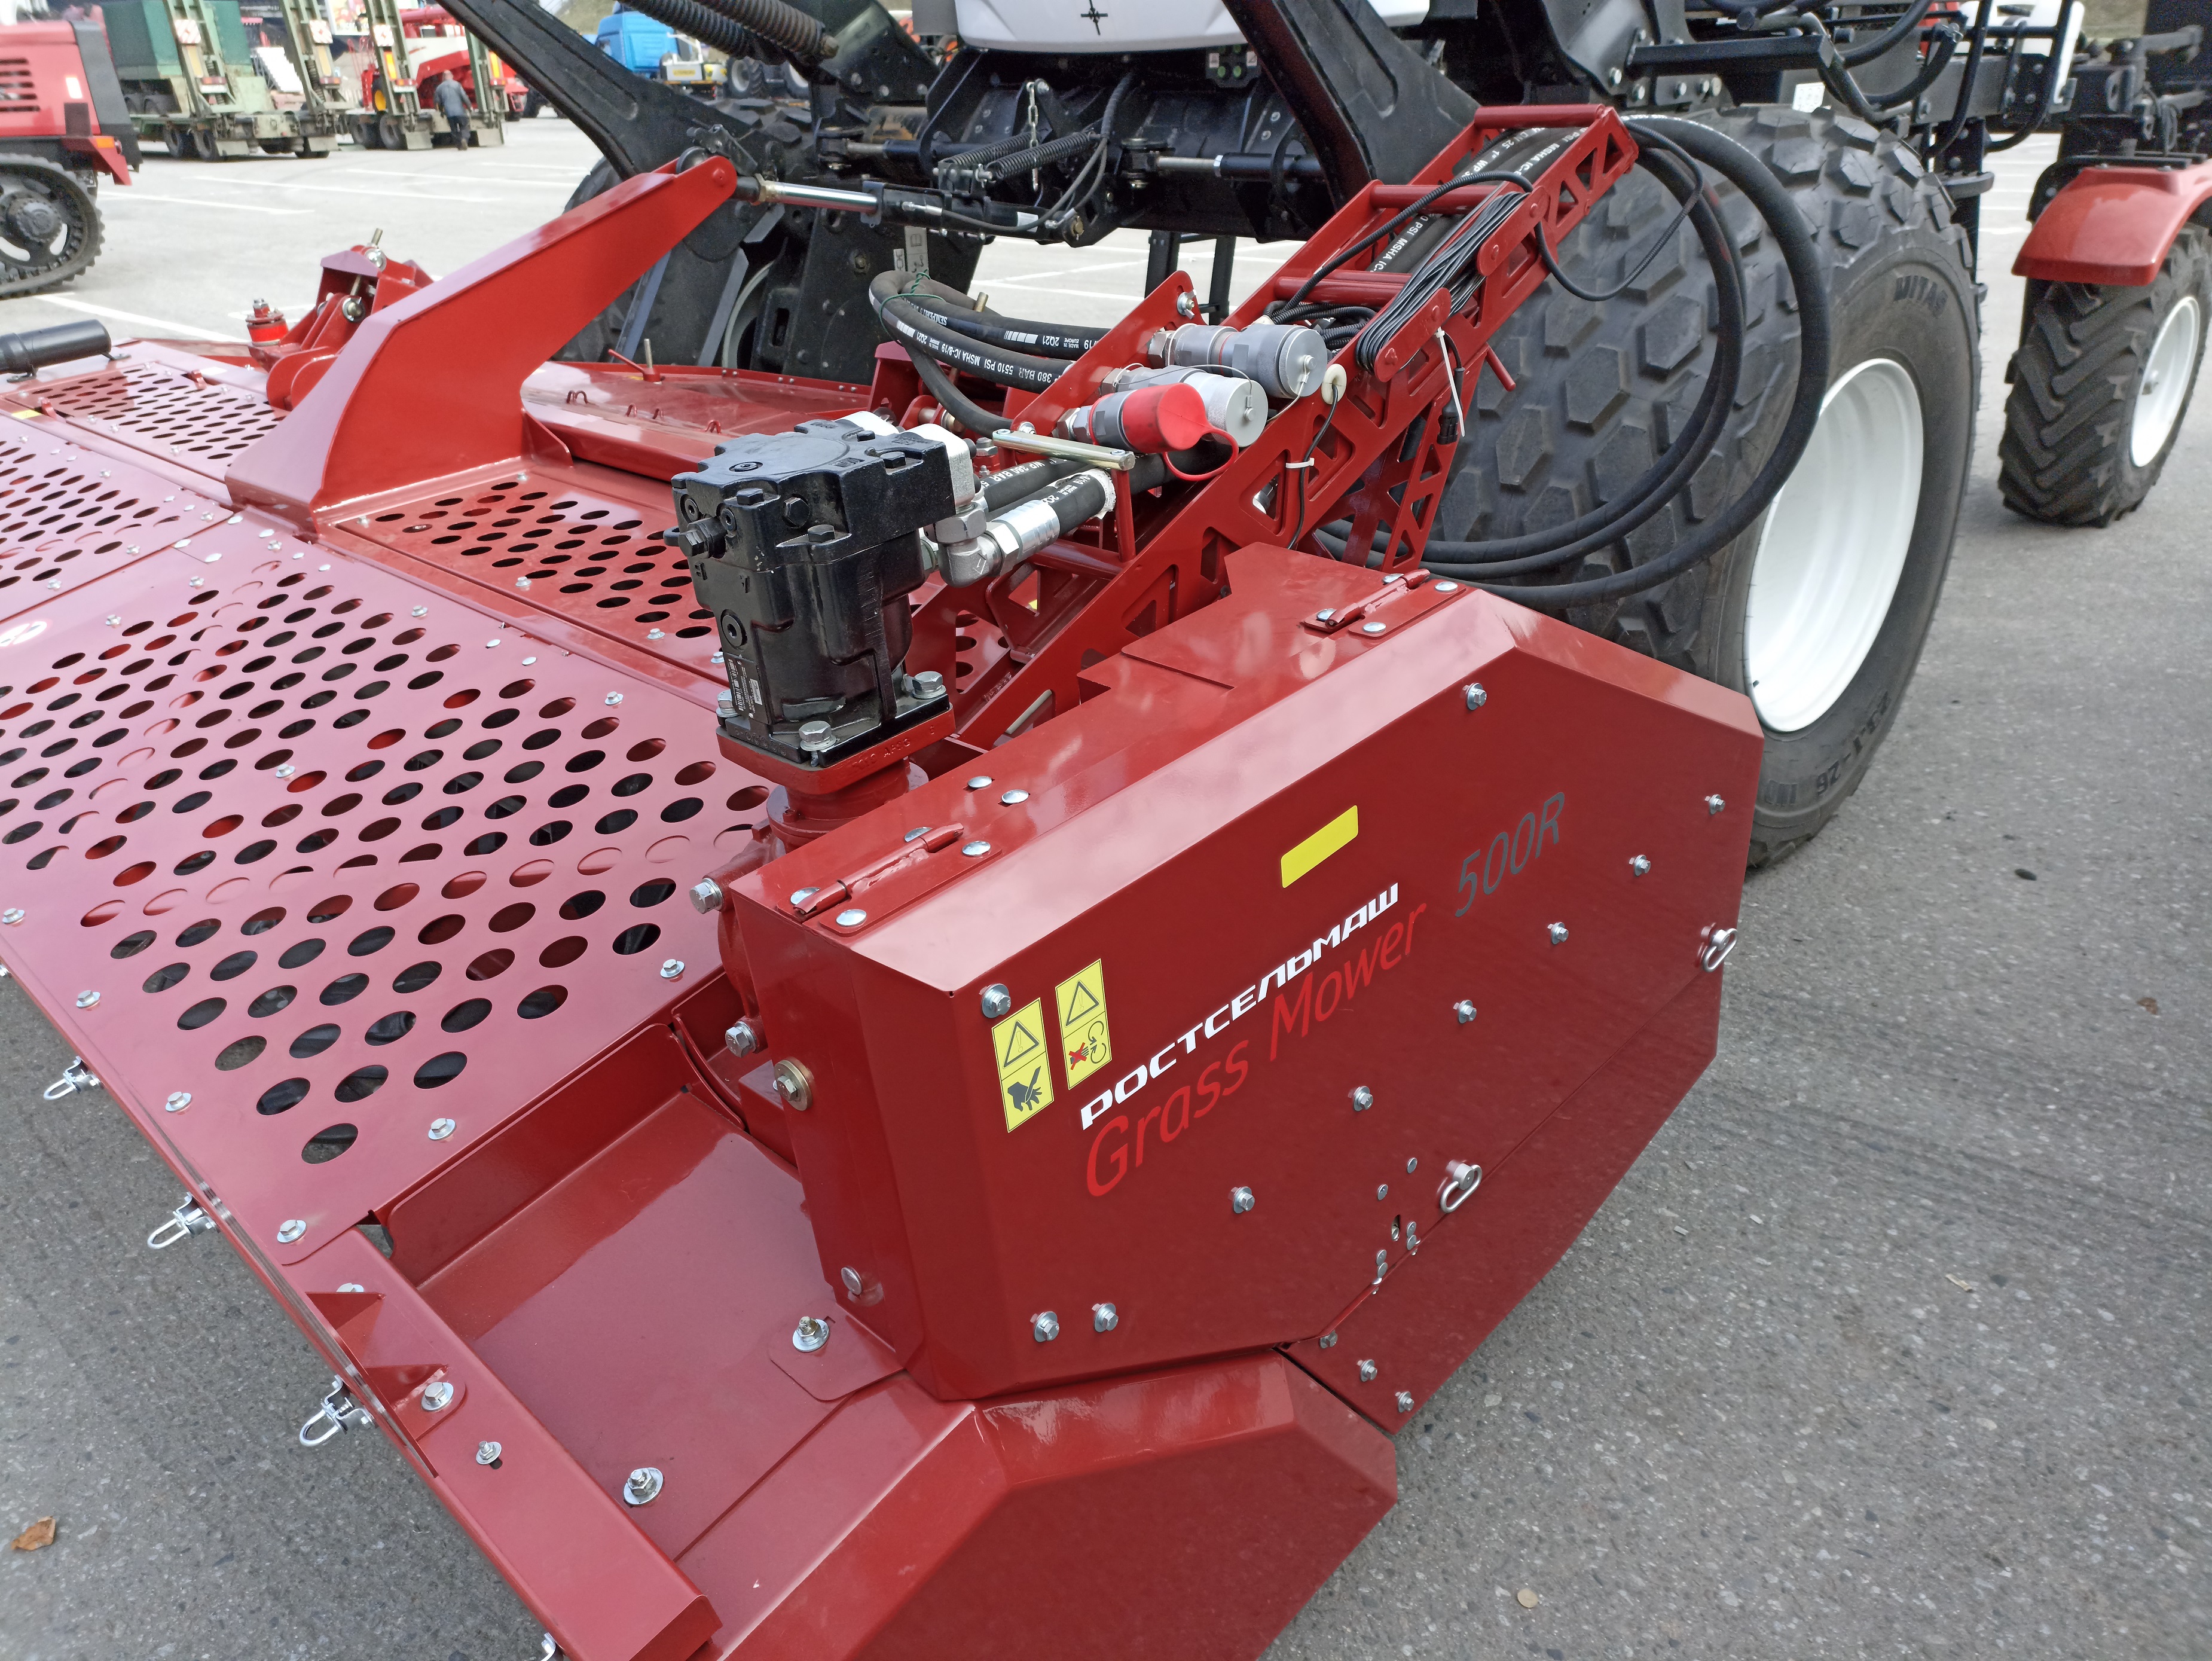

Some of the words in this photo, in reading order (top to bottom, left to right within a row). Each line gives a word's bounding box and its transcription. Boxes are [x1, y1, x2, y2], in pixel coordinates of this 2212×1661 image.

[1502, 139, 1514, 149] 25
[1530, 143, 1560, 161] MSHA
[1473, 160, 1488, 172] WP
[1407, 222, 1423, 236] PSI
[1383, 238, 1408, 260] MSHA
[916, 331, 928, 344] 2Q21
[1042, 335, 1060, 347] 2Q21
[941, 343, 961, 359] IC-8/19
[962, 351, 980, 366] MSHA
[984, 359, 996, 371] PSI
[997, 362, 1014, 375] 5510
[1018, 367, 1035, 380] BAR
[1037, 371, 1052, 383] 380
[1012, 465, 1029, 474] 380
[1029, 461, 1045, 469] WP
[989, 471, 1012, 482] BAR
[1086, 1040, 1248, 1196] Grass
[1270, 903, 1427, 1061] Mower
[1455, 792, 1565, 917] 500R
[1080, 883, 1398, 1131] РОСТСЕЛЬМАШ
